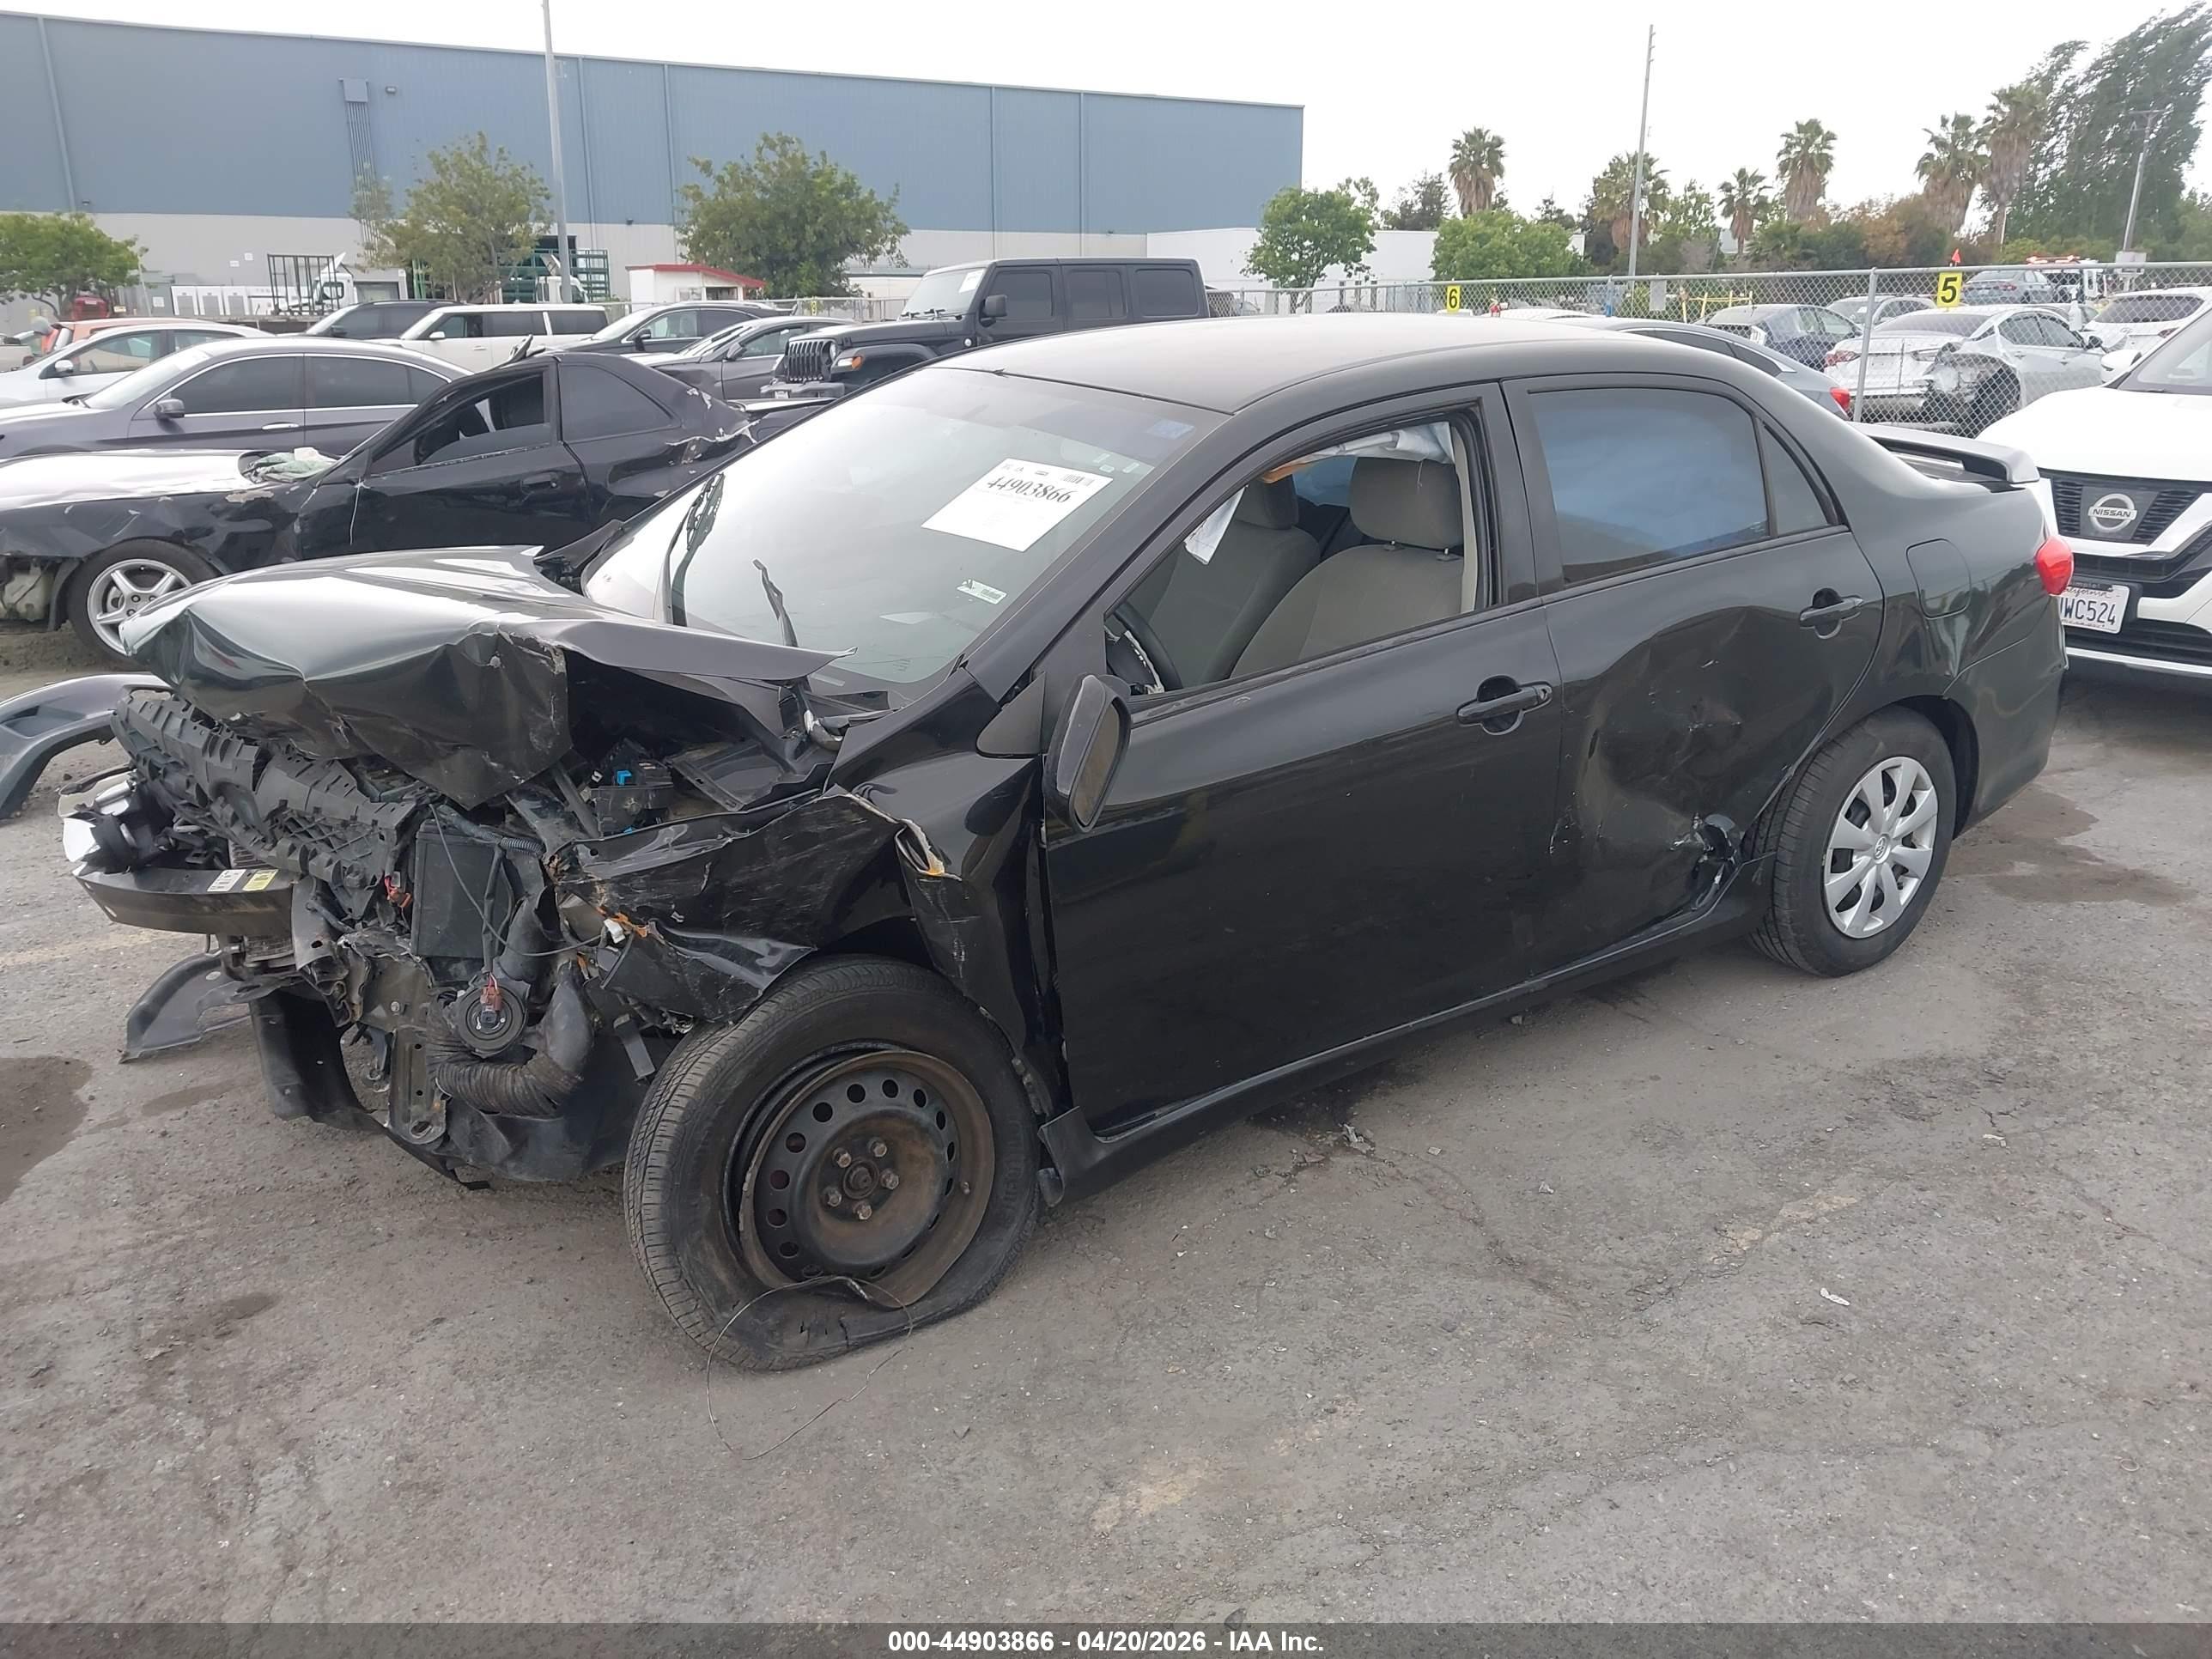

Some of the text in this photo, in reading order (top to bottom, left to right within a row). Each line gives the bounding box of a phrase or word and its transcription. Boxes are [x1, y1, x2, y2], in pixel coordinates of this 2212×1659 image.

[1449, 288, 1458, 308] 6
[1941, 276, 1958, 303] 5
[988, 476, 1079, 502] 44903866
[2093, 508, 2130, 518] NISSAN
